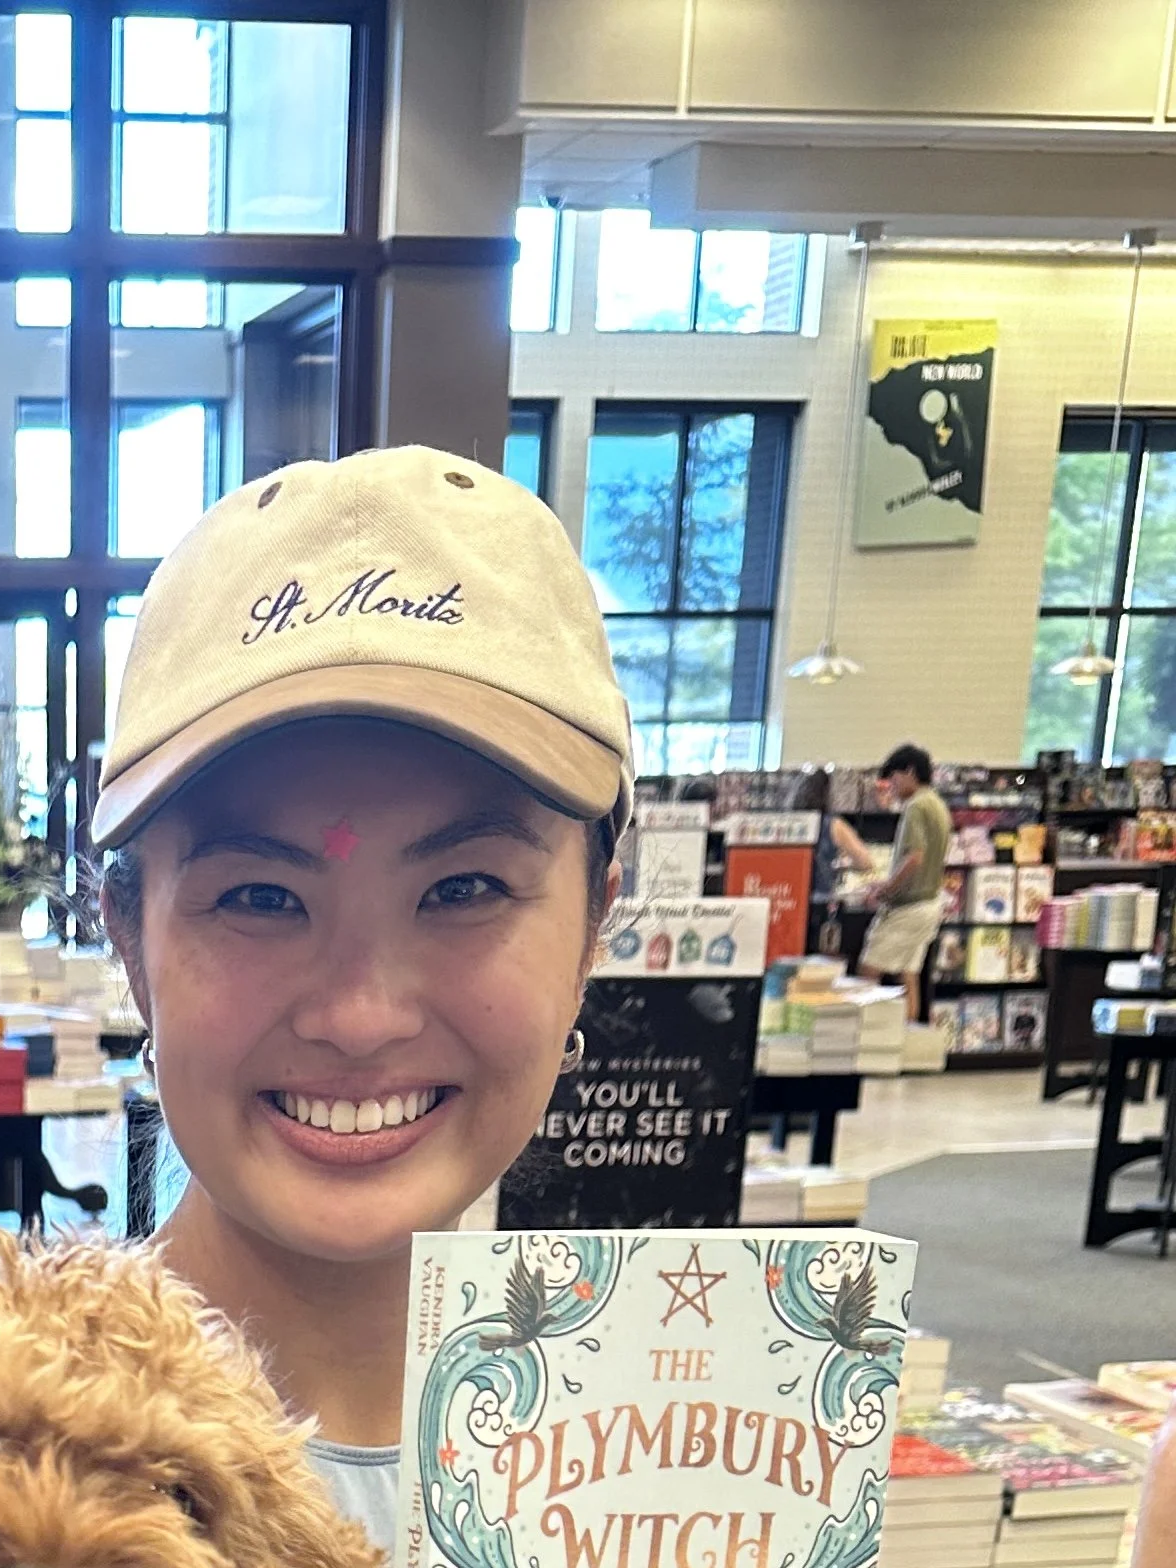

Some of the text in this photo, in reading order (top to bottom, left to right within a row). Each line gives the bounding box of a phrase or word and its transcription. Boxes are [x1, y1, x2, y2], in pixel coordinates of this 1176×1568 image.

[242, 568, 464, 645] St. Moritz
[576, 1055, 702, 1072] EW MYSTERIES
[576, 1080, 684, 1108] YOU'LL
[635, 1108, 692, 1137] SEE
[701, 1108, 732, 1136] IT
[564, 1139, 686, 1168] COMING
[417, 1256, 433, 1356] VAUGHAN
[430, 1266, 445, 1350] KENDRA
[649, 1348, 714, 1382] THE
[493, 1401, 855, 1522] PLYMBURY
